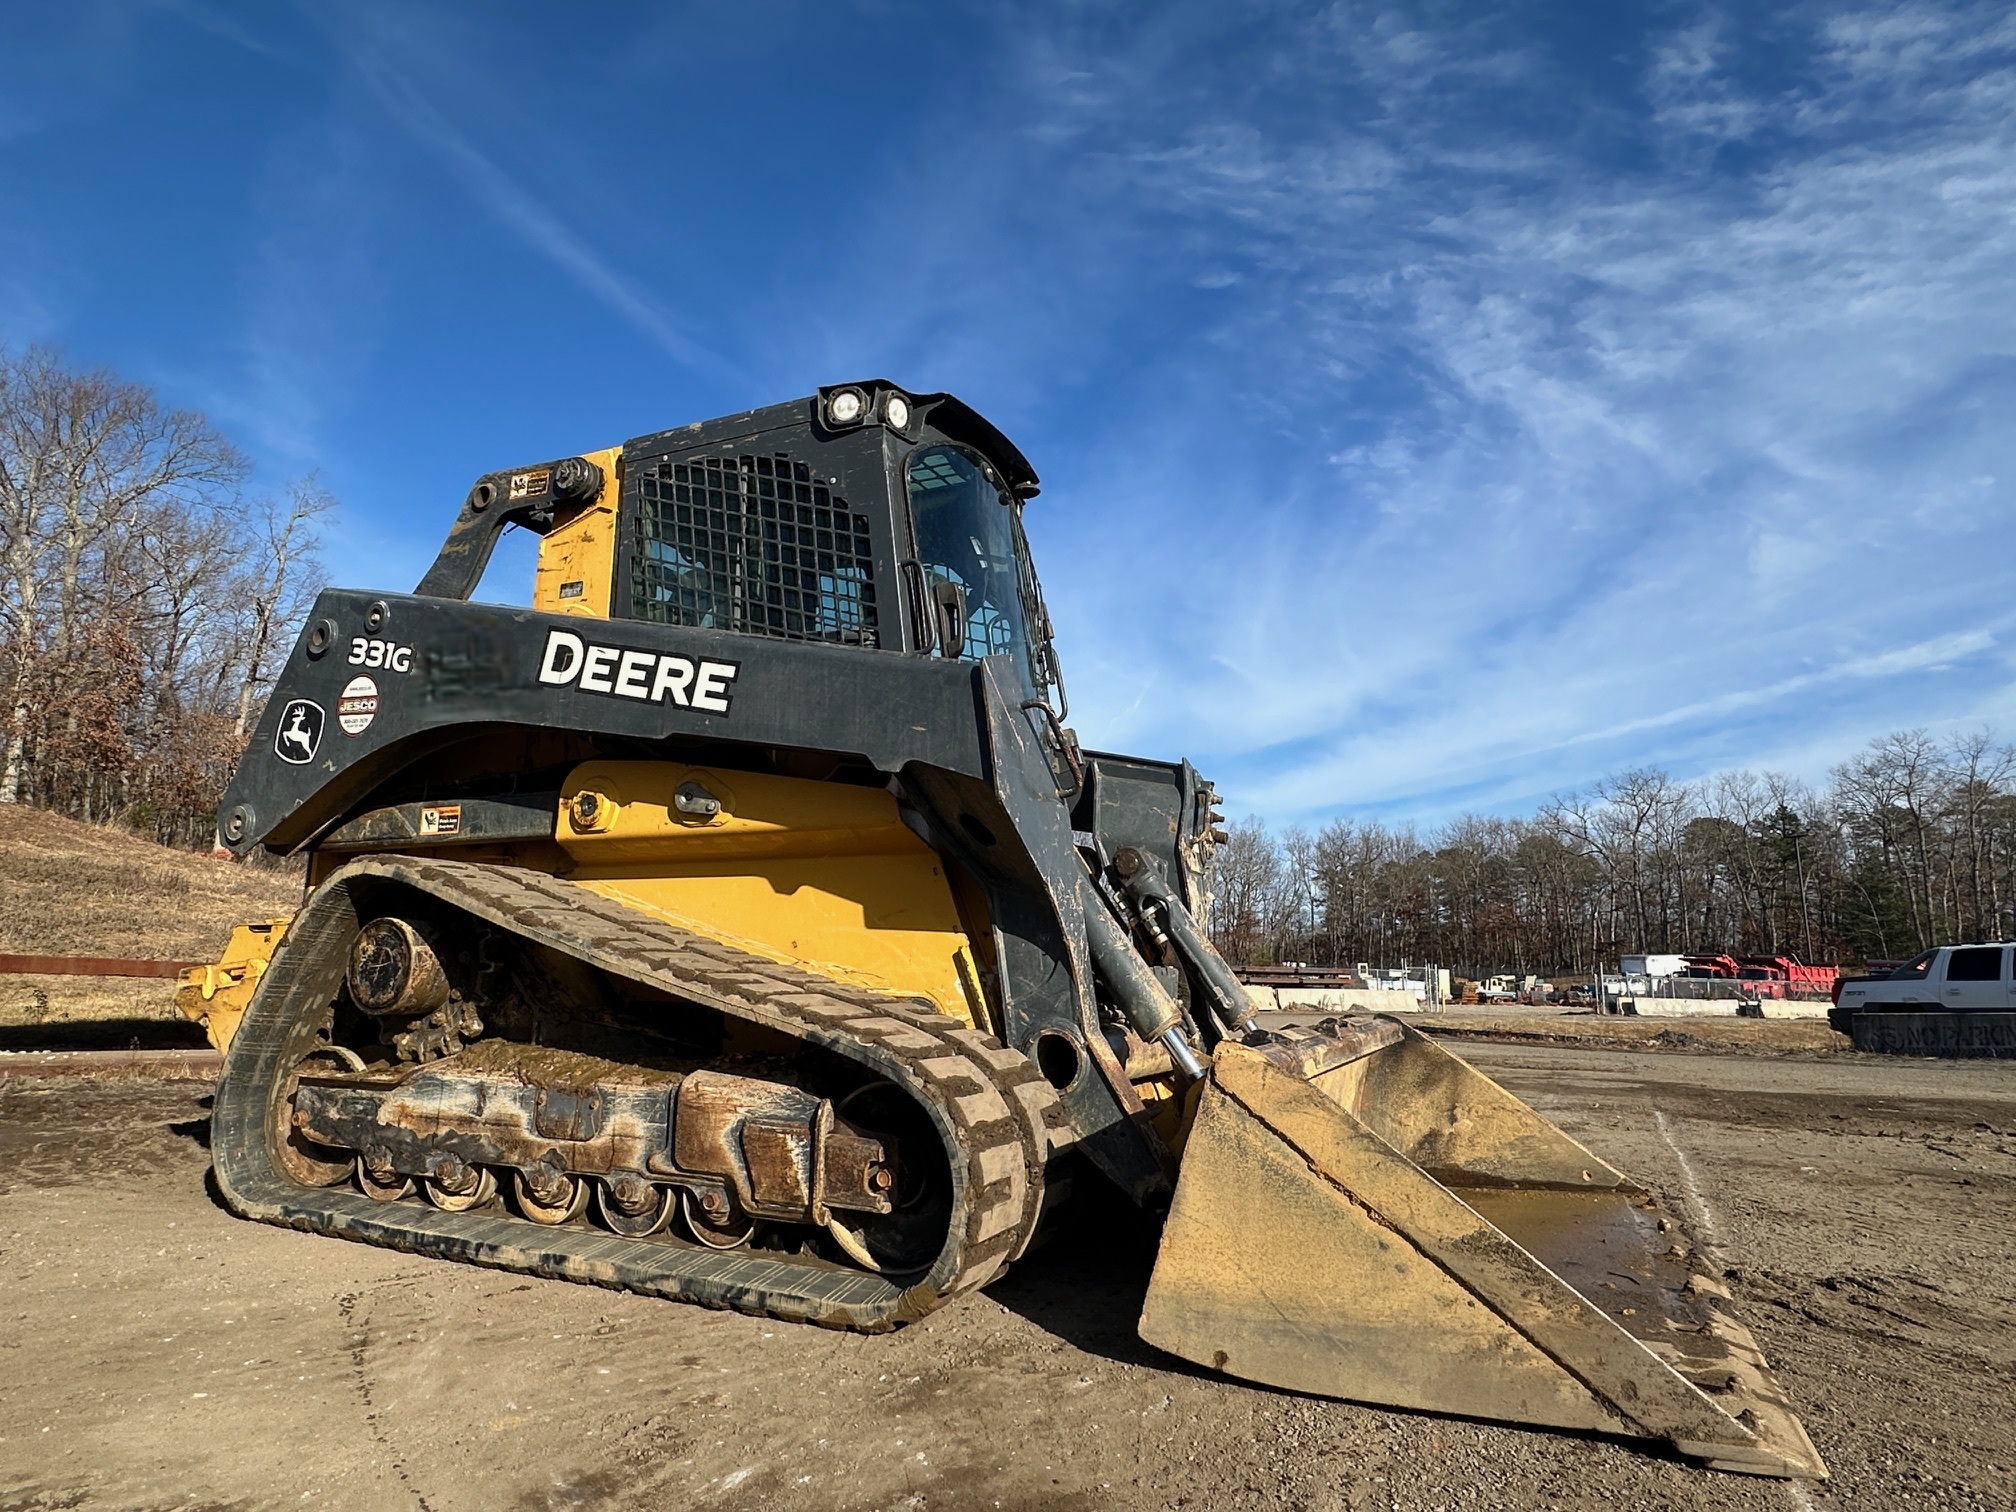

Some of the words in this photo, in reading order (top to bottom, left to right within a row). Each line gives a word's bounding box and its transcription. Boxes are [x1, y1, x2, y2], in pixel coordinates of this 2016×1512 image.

[347, 637, 412, 673] 331G
[538, 630, 737, 712] DEERE
[339, 699, 377, 712] JESCO
